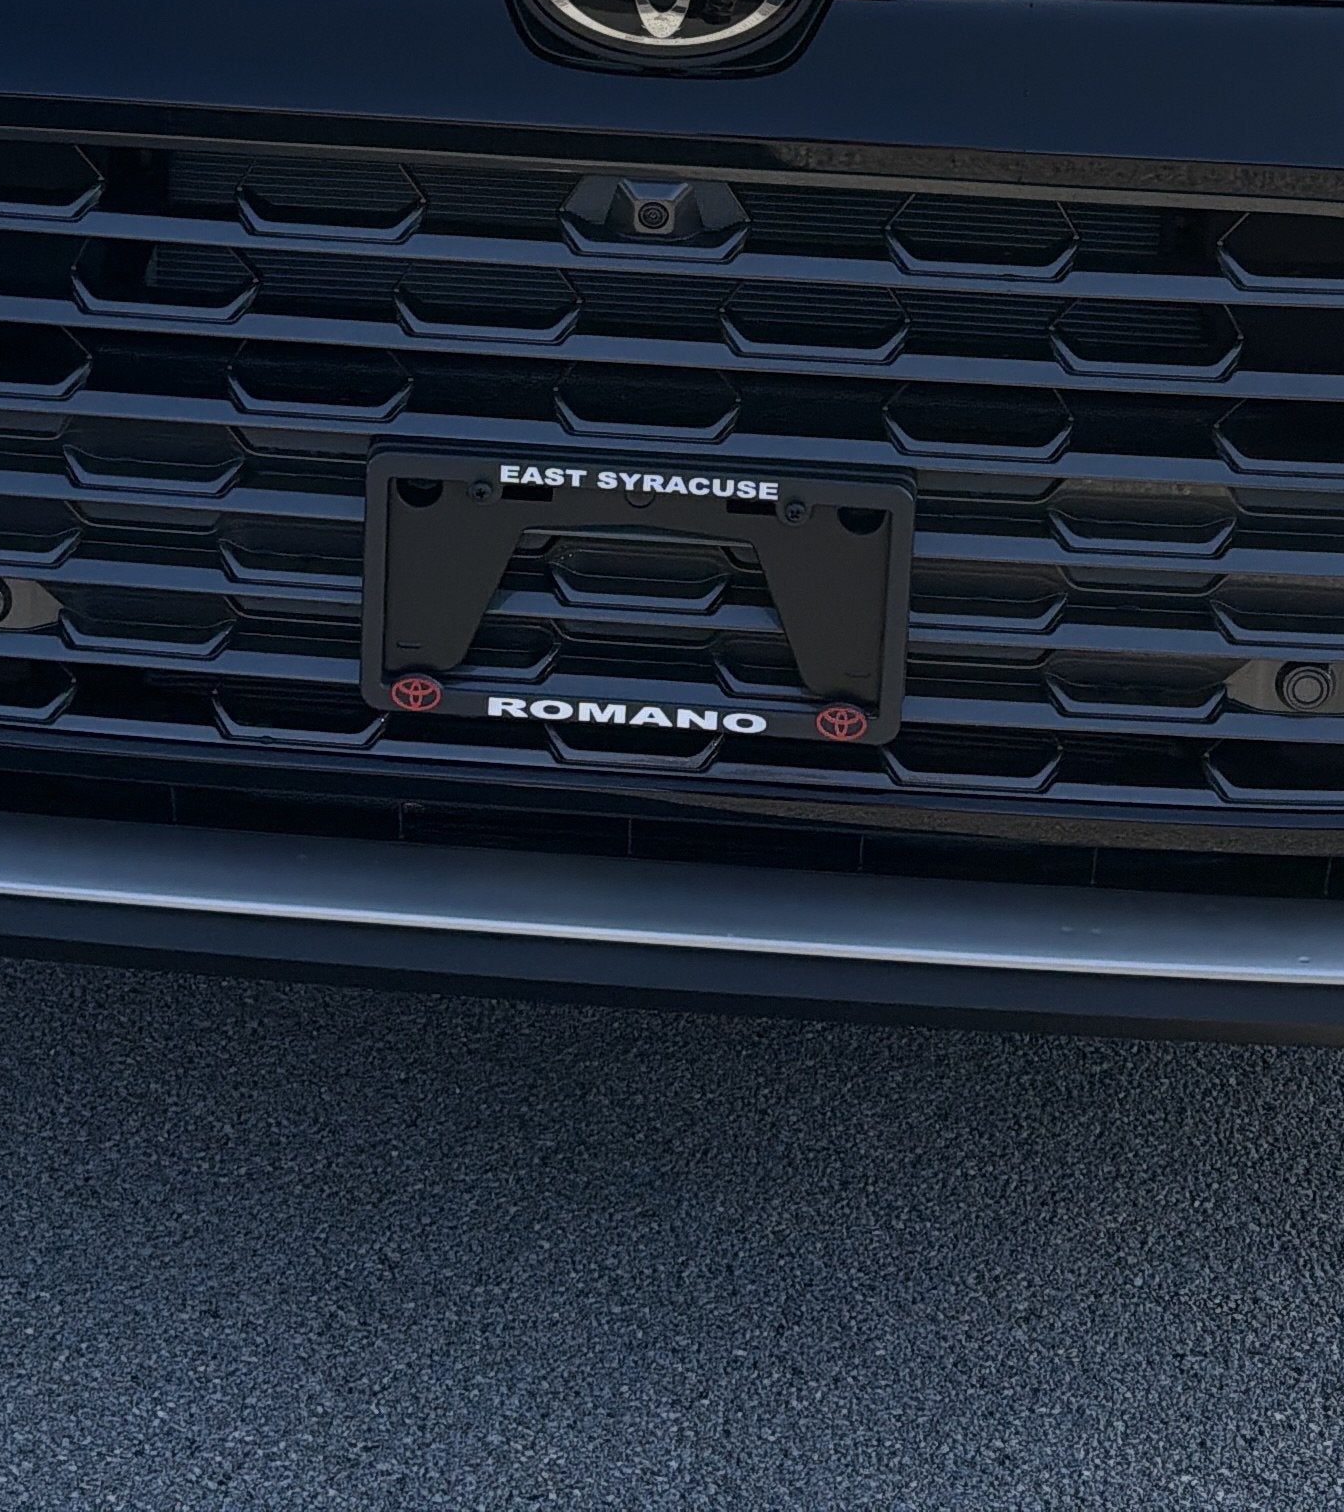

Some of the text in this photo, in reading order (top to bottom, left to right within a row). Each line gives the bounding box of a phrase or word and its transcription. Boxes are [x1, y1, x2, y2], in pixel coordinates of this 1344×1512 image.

[499, 464, 779, 501] EAST SYRACUSE
[487, 696, 768, 735] ROMANO
